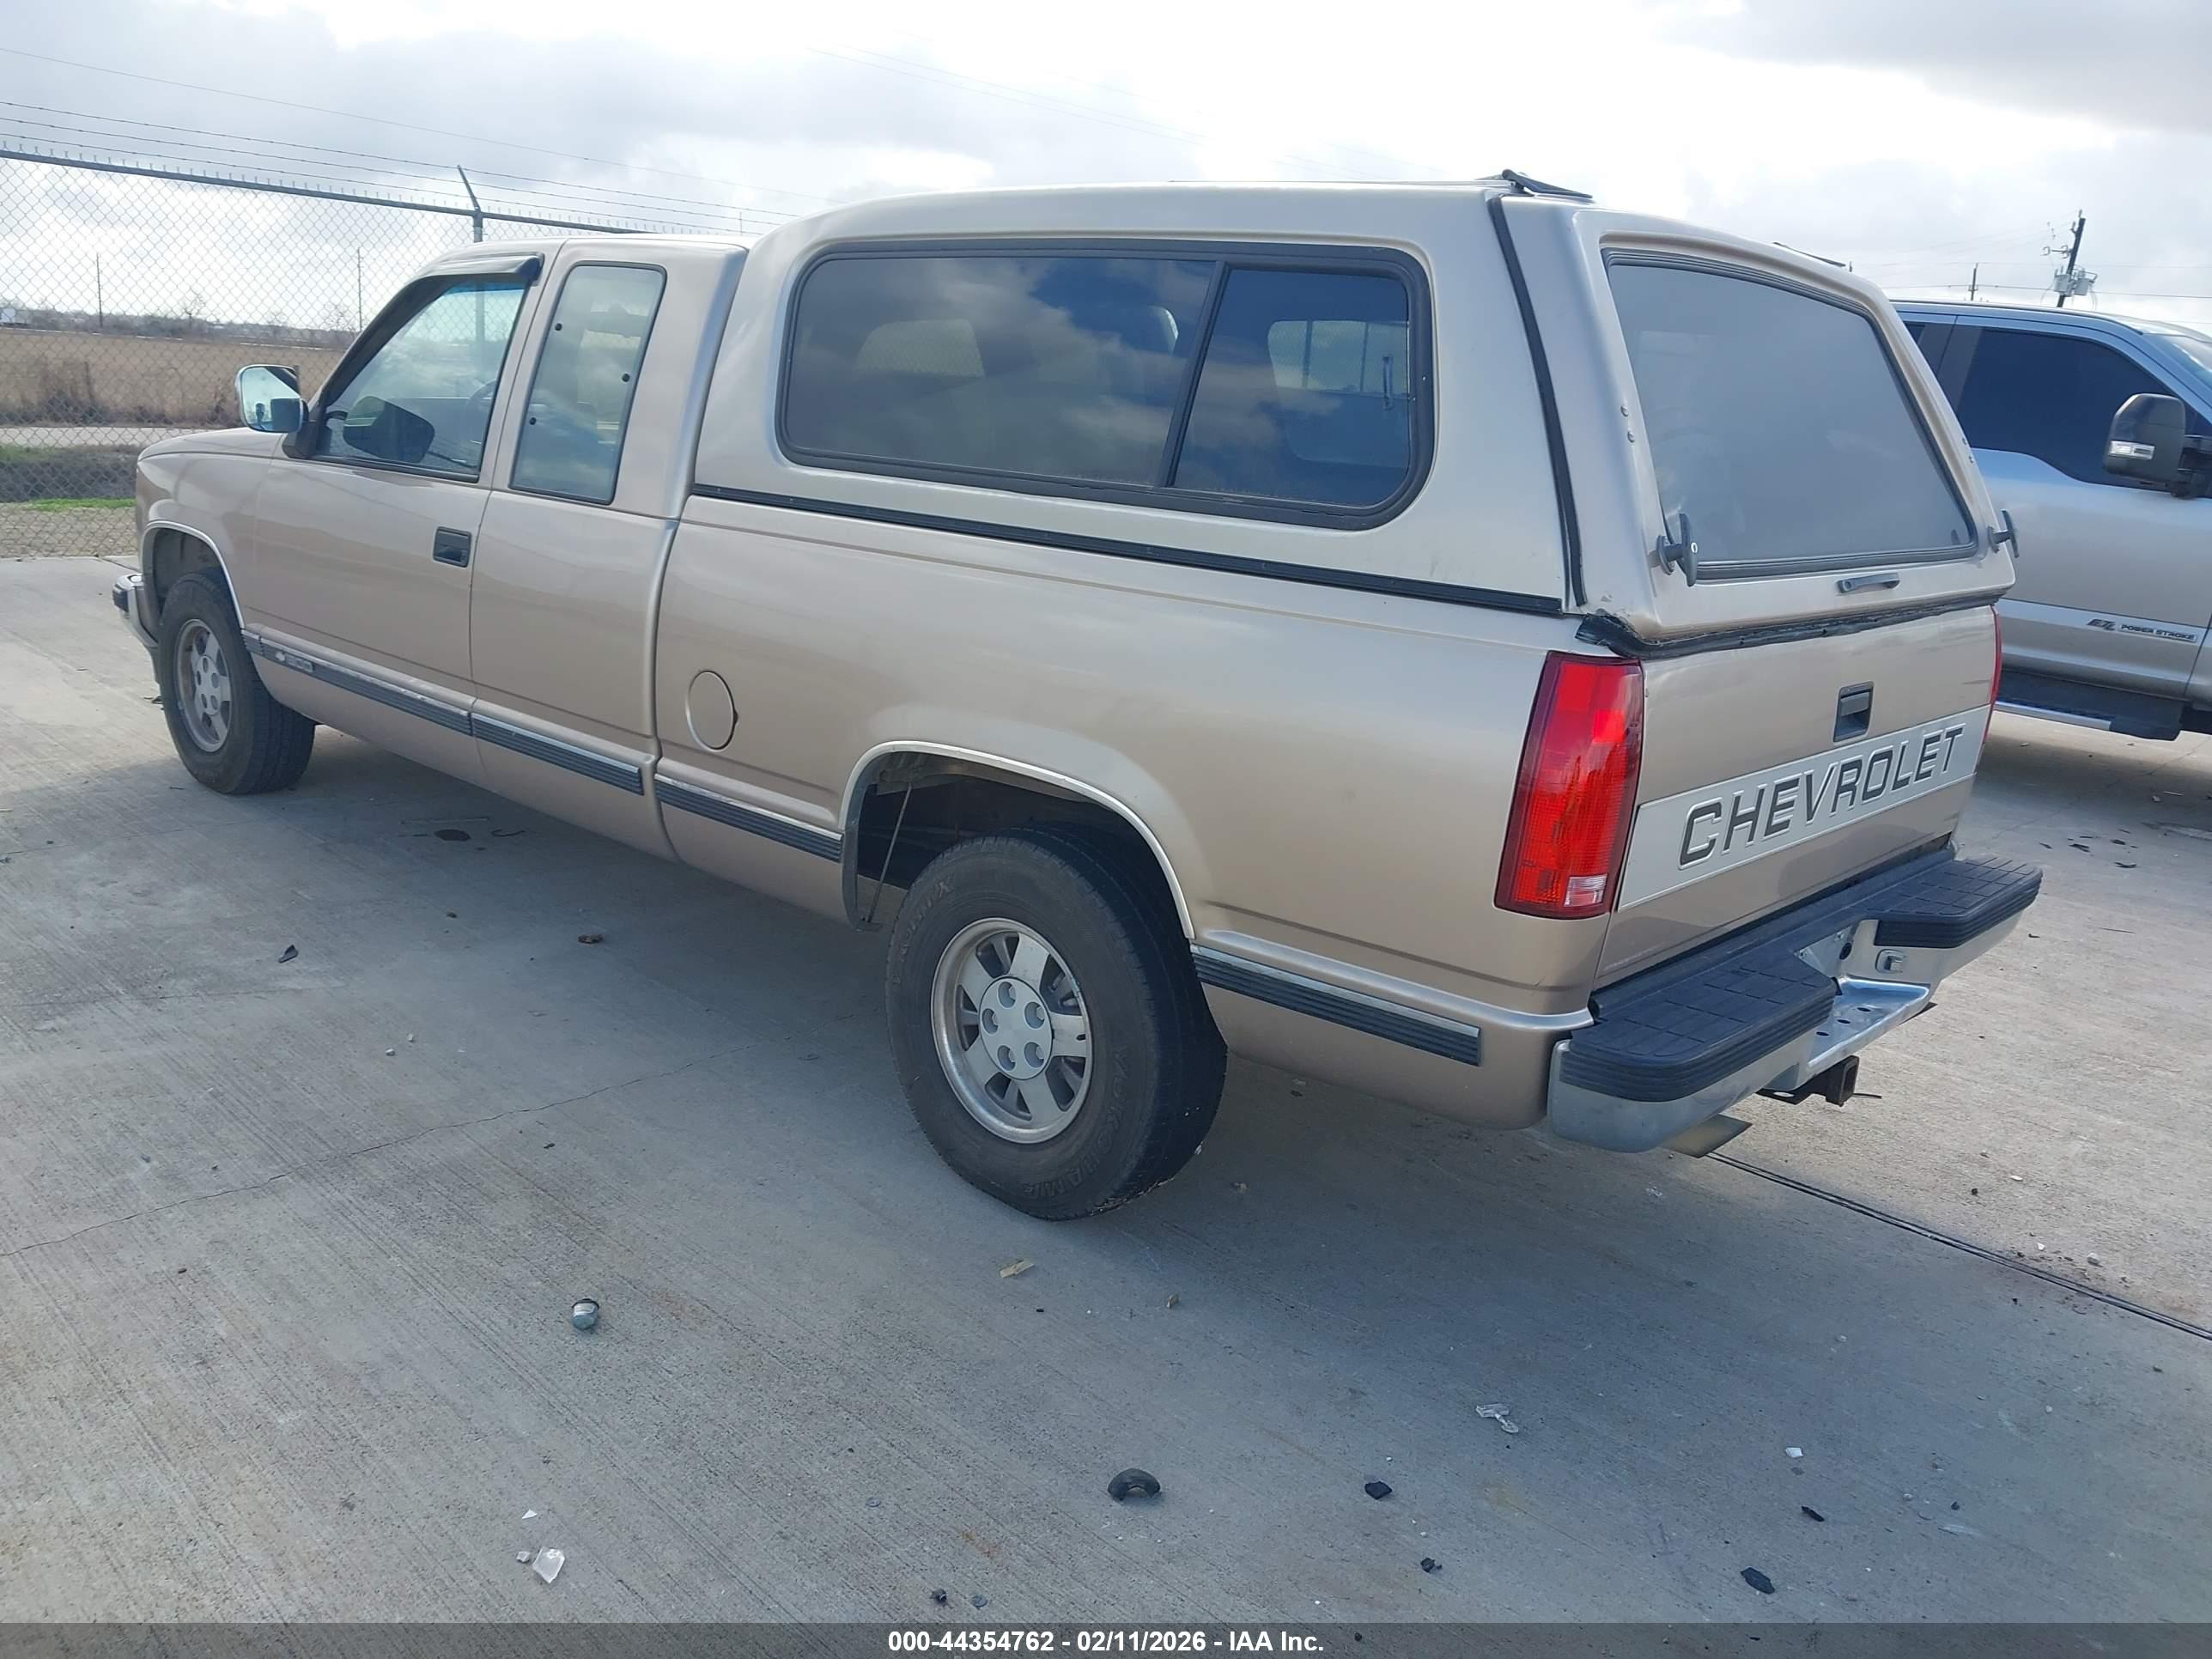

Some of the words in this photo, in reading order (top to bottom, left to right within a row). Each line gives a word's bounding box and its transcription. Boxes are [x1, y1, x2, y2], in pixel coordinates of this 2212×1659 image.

[2121, 624, 2154, 634] POWER
[2155, 629, 2195, 641] STROKE
[1678, 724, 1966, 869] CHEVROLET
